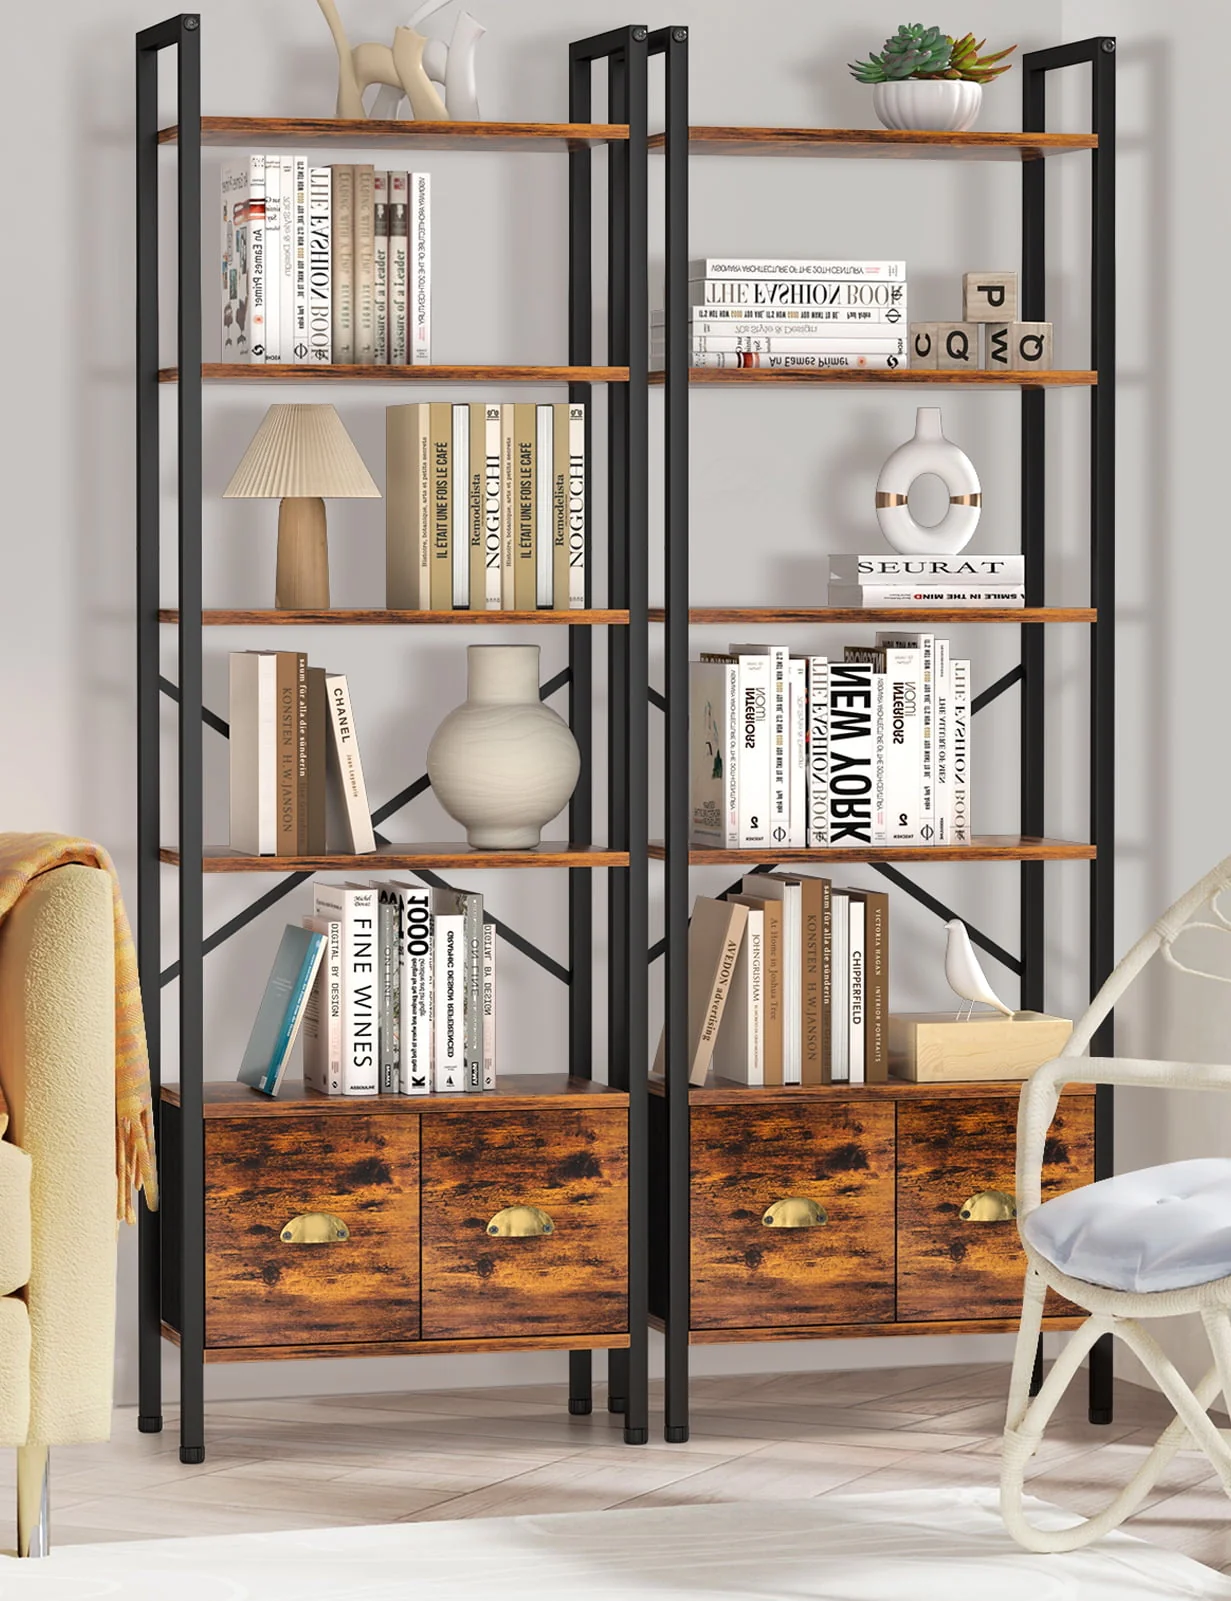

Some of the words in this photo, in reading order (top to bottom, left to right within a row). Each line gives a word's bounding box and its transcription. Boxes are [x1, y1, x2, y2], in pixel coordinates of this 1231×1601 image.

[374, 249, 386, 287] Leader
[393, 249, 405, 287] Leader
[374, 299, 386, 312] of
[393, 299, 405, 312] of
[977, 286, 1005, 307] P
[915, 333, 931, 357] C
[946, 331, 969, 361] Q
[1019, 334, 1045, 361] Q
[433, 442, 448, 466] CAFÉ
[517, 442, 532, 466] CAFÉ
[436, 467, 448, 478] LE
[520, 467, 532, 478] LE
[436, 480, 448, 501] FOIS
[520, 480, 532, 501] FOIS
[436, 502, 448, 522] UNE
[471, 474, 481, 546] Remodelista
[486, 455, 500, 568] NOGUCHI
[520, 502, 532, 522] UNE
[555, 474, 565, 546] Remodelista
[570, 455, 584, 568] NOGUCHI
[434, 523, 448, 549] ÉTAIT
[518, 523, 532, 549] ÉTAIT
[436, 550, 448, 559] IL
[520, 550, 532, 559] IL
[858, 561, 1005, 574] SEURAT
[283, 687, 293, 746] KONSTEN
[333, 688, 350, 743] CHANEL
[771, 918, 778, 927] At
[331, 923, 339, 960] DIGITAL
[353, 919, 372, 973] FINE
[807, 915, 817, 973] KONSTEN
[331, 966, 339, 977] BY
[720, 940, 737, 986] AVEDON
[771, 958, 778, 968] in
[769, 969, 778, 998] Joshua
[852, 951, 862, 1025] CHIPPERFIELD
[331, 983, 339, 1017] DESIGN
[353, 985, 373, 1068] WINES
[702, 988, 724, 1041] advertising
[412, 1076, 425, 1086] K
